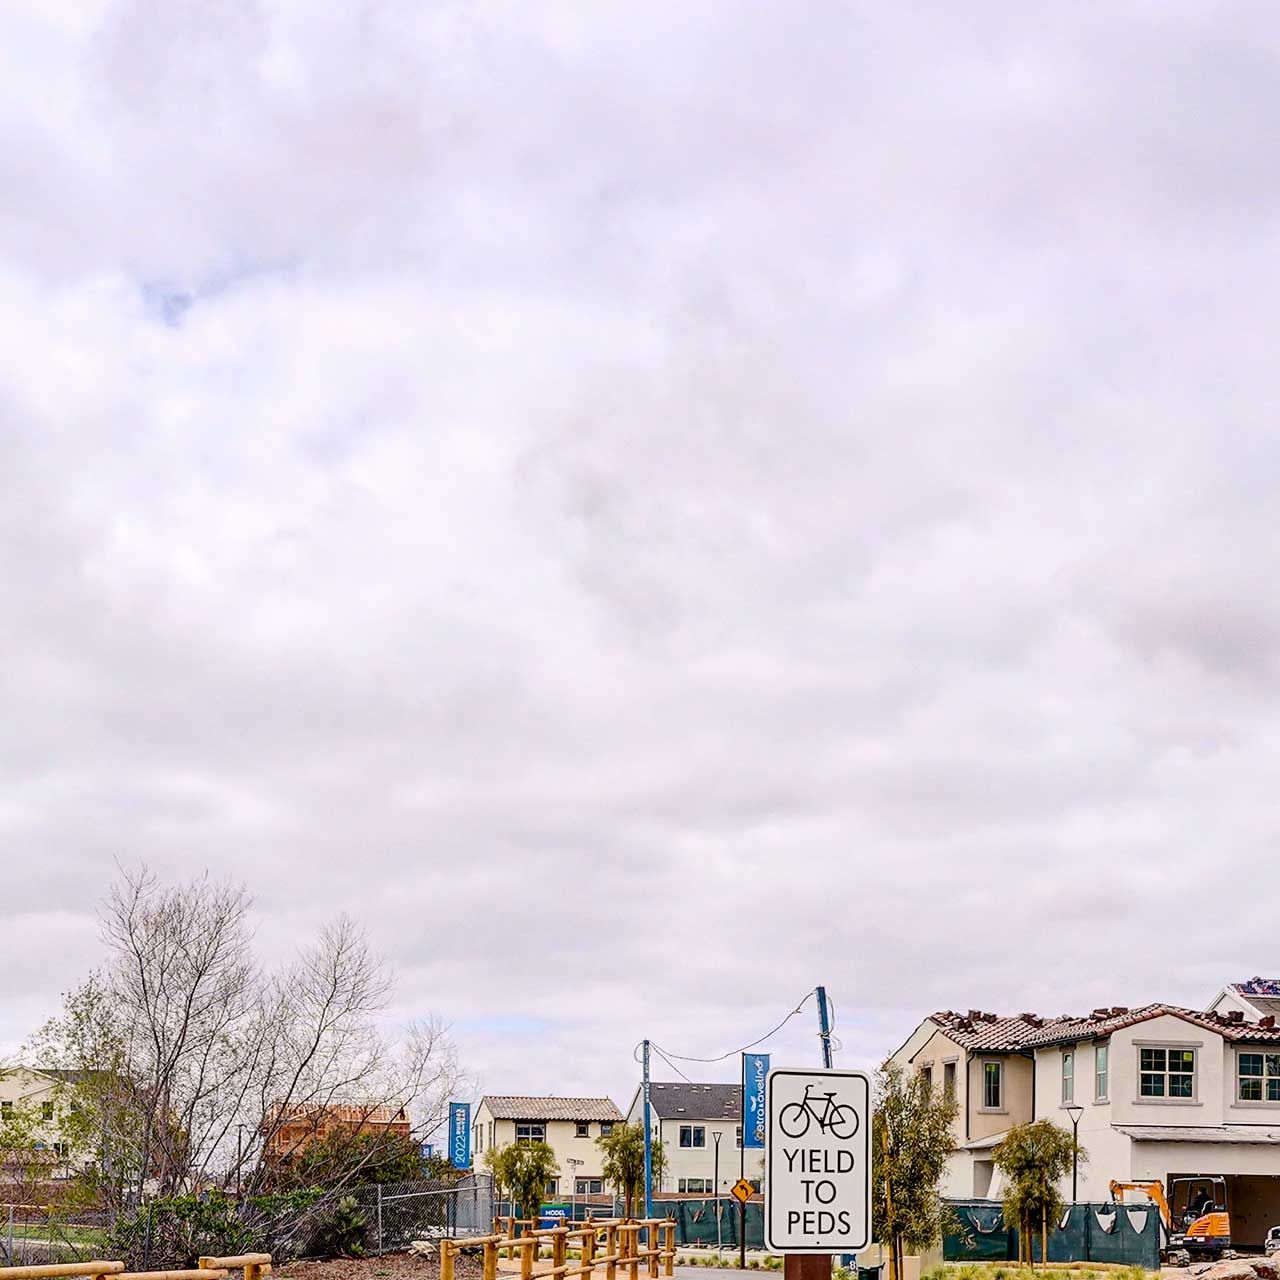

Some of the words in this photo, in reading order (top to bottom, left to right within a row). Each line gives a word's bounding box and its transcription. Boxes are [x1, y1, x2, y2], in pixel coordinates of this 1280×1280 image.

[455, 1136, 466, 1163] 2022
[783, 1149, 854, 1173] YIELD
[800, 1180, 836, 1204] TO
[788, 1211, 851, 1235] PEDS
